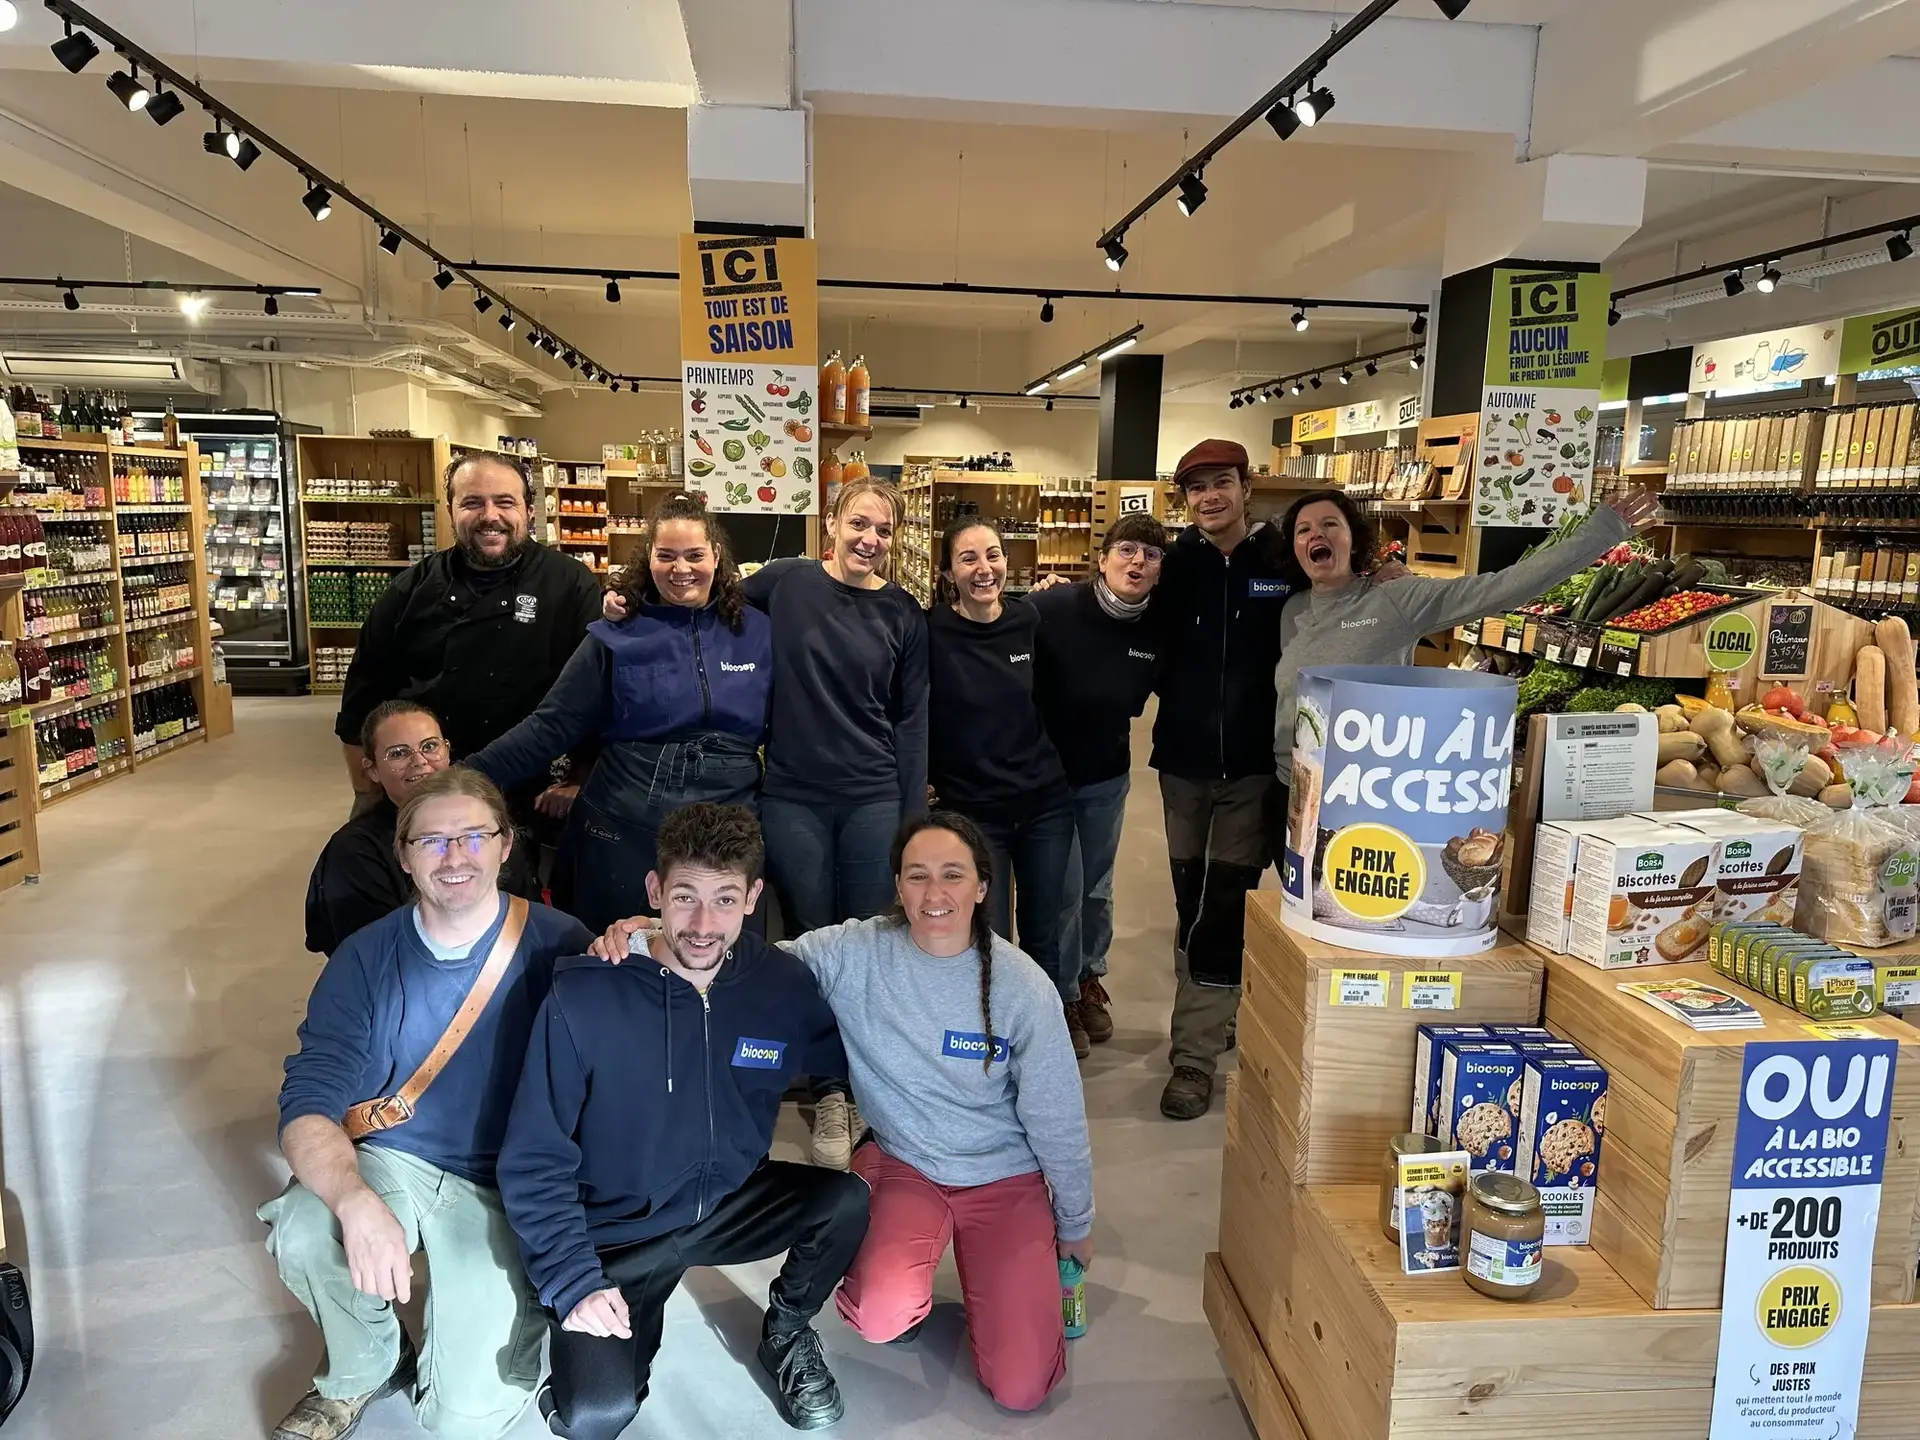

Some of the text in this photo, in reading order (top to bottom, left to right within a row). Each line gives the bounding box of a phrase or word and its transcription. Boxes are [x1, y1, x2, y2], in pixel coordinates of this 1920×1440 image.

[701, 248, 778, 285] ICI
[704, 296, 789, 319] TOUT EST DE
[1512, 282, 1576, 317] ICI
[708, 319, 794, 354] SAISON
[1509, 326, 1568, 354] AUCUN
[1872, 320, 1920, 355] OUI
[1510, 350, 1589, 370] FRUIT OU LÉGUME
[687, 367, 754, 386] PRINTEMPS
[1510, 367, 1576, 382] NE PREND L'AVION
[1487, 392, 1536, 408] AUTOMNE
[1399, 402, 1415, 420] OUI
[1121, 498, 1147, 511] ICI
[1253, 582, 1291, 594] biocoop
[1341, 617, 1378, 629] biocoop
[1709, 631, 1752, 652] LOCAL
[720, 660, 756, 672] biocoop
[1771, 659, 1799, 671] France
[1334, 708, 1516, 764] OUI À LA
[1350, 846, 1396, 874] PRIX
[1726, 847, 1751, 856] BORSA
[1637, 858, 1663, 868] BORSA
[1718, 860, 1764, 874] scottes
[1335, 868, 1410, 900] ENGAGÉ
[1617, 872, 1676, 888] Biscottes
[1343, 972, 1379, 981] PRIX ENGAGÉ
[1415, 974, 1451, 983] PRIX ENGAGÉ
[1830, 979, 1855, 987] Phare
[740, 1043, 779, 1064] biocoop
[950, 1035, 1002, 1058] biocop
[1466, 1061, 1514, 1077] biocoop
[1551, 1078, 1599, 1094] biocoop
[1746, 1054, 1890, 1120] OUI
[1765, 1125, 1860, 1152] À LA BIO
[1744, 1155, 1873, 1180] ACCESSIBLE
[1541, 1192, 1584, 1201] COOKIES
[1770, 1196, 1842, 1239] 200
[1768, 1241, 1839, 1260] PRODUITS
[1781, 1286, 1819, 1307] PRIX
[1766, 1302, 1830, 1329] ENGAGÉ
[1770, 1362, 1816, 1375] DES PRIX
[1772, 1379, 1810, 1391] JUSTES
[1735, 1392, 1842, 1407] qui mettent tout le monde
[1741, 1405, 1835, 1417] d'accord, du producteur
[1750, 1418, 1824, 1428] au consommateur
